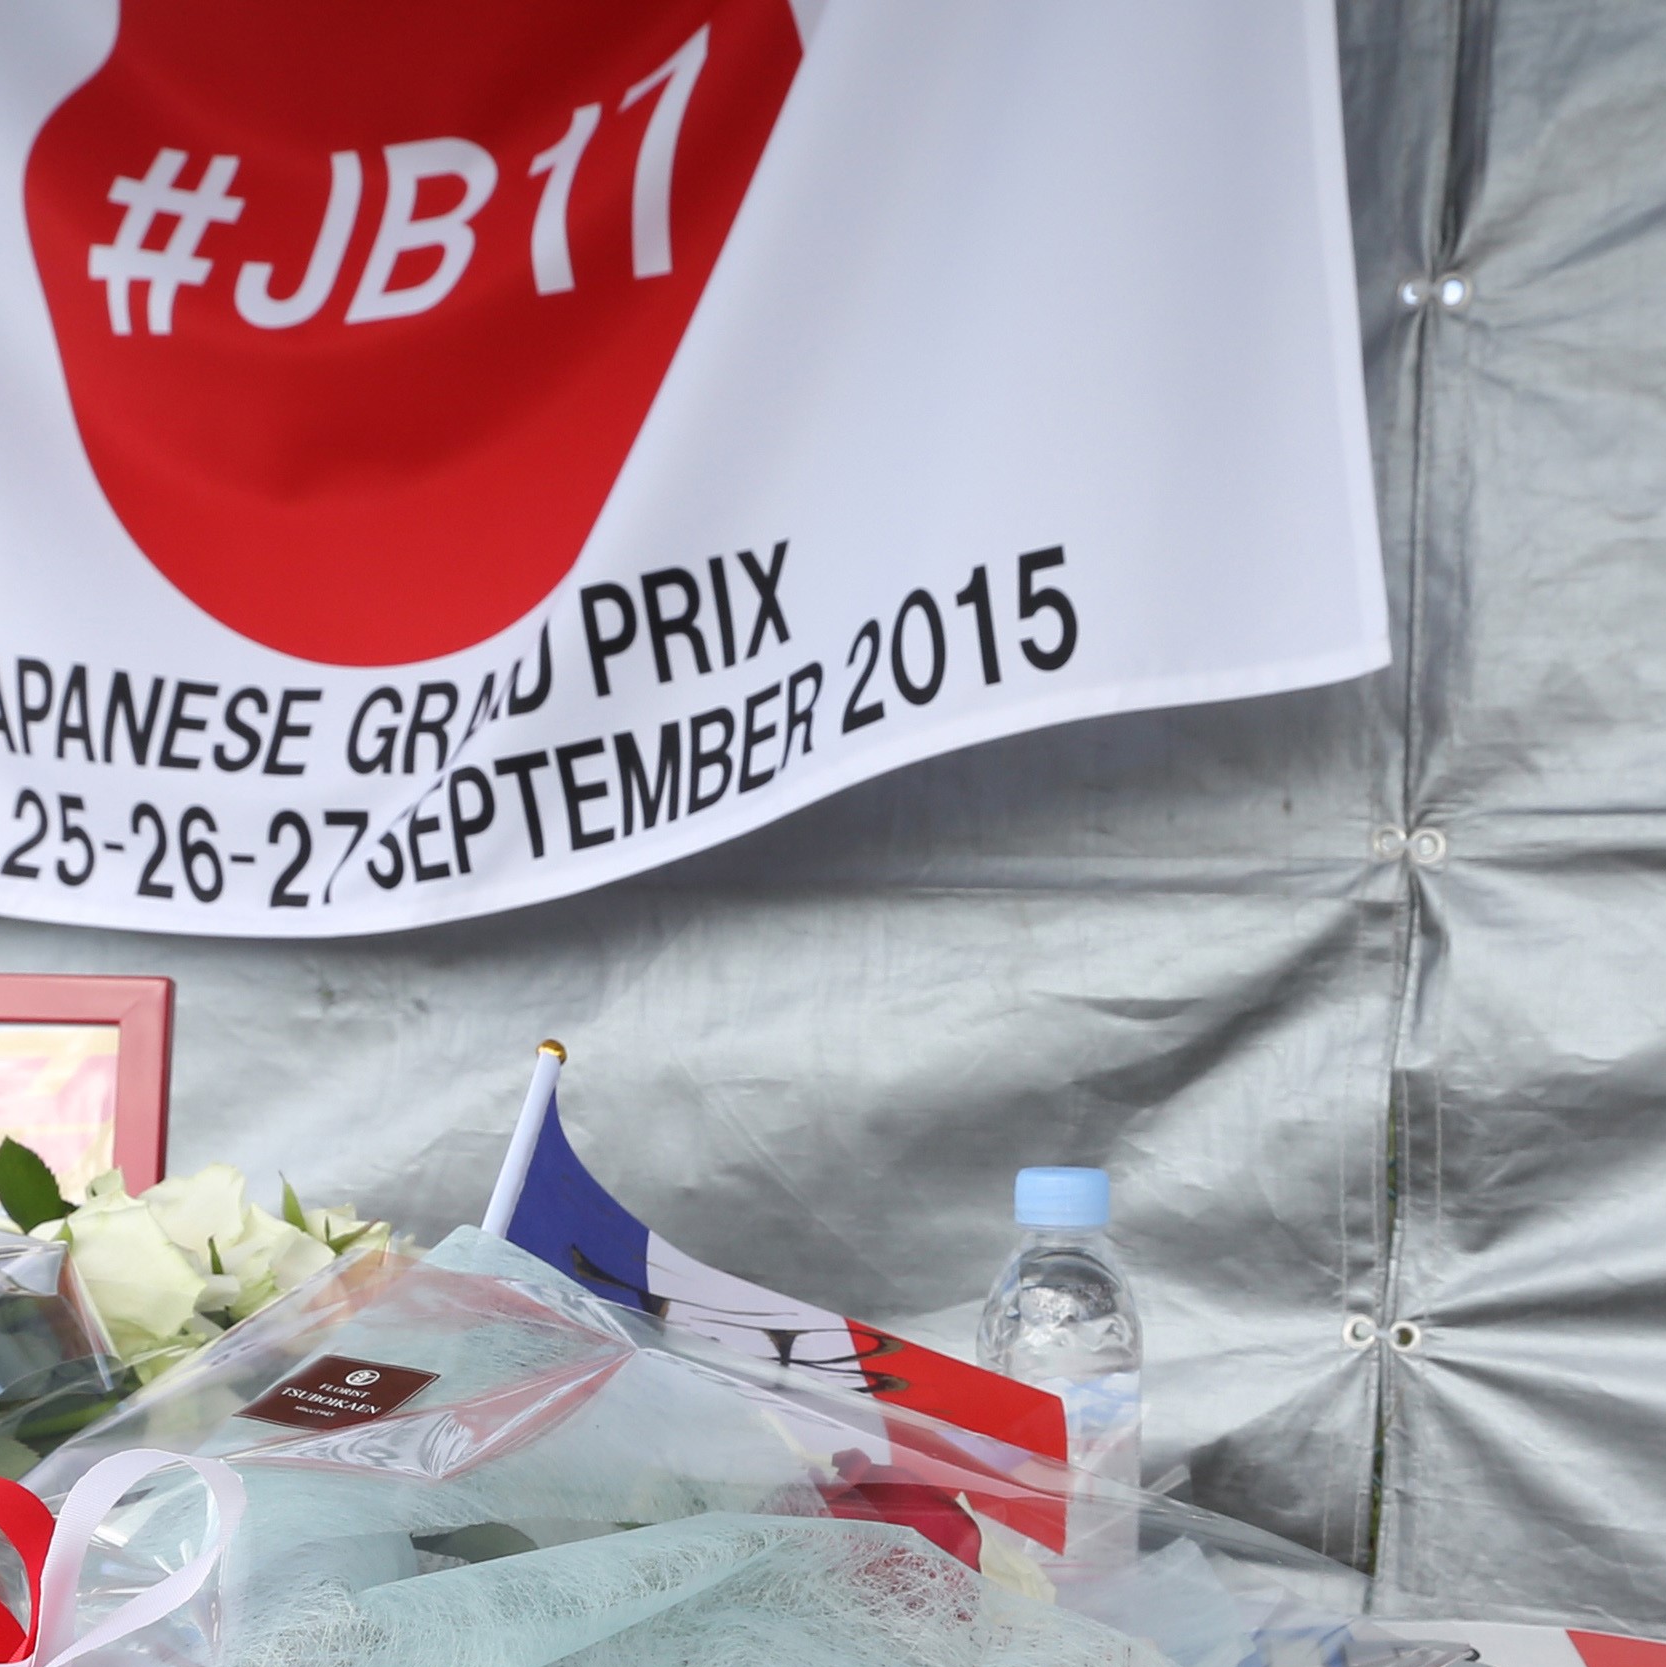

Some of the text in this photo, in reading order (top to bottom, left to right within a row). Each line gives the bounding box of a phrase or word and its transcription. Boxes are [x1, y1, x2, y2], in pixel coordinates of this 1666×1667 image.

[89, 22, 710, 336] #JB17
[580, 539, 791, 697] PRIX
[0, 788, 369, 908] 25-26-27
[366, 661, 824, 890] SEPTEMBER
[841, 545, 1078, 737] 2015
[281, 1386, 382, 1414] TSUBOIKAEN
[318, 1382, 371, 1399] FLORIST
